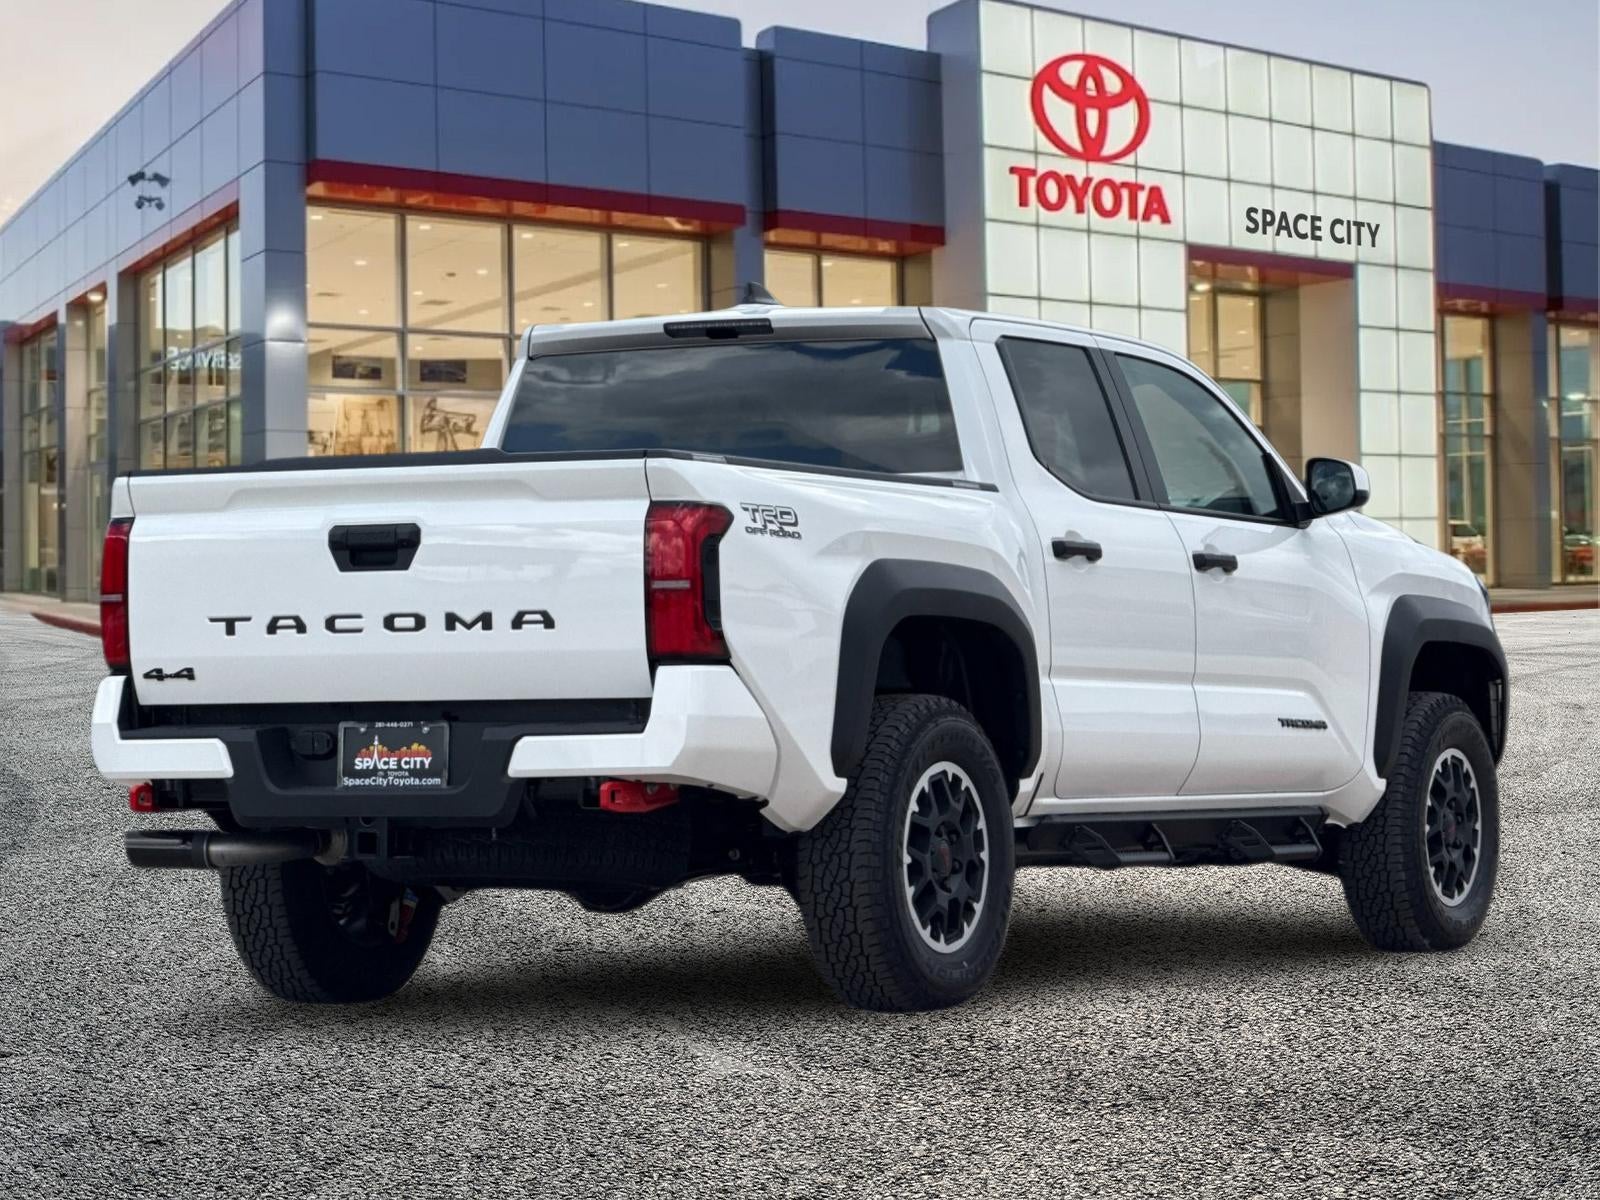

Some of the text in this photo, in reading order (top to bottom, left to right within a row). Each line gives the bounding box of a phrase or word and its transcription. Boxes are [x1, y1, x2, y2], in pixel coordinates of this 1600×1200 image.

[1009, 166, 1171, 224] TOYOTA
[1245, 206, 1381, 248] SPACE CITY
[740, 502, 799, 529] TRD
[745, 526, 802, 540] OFF ROAD
[208, 609, 556, 636] TACOMA
[354, 757, 432, 770] SPACE CITY
[343, 776, 441, 787] SpaceCityToyota.com
